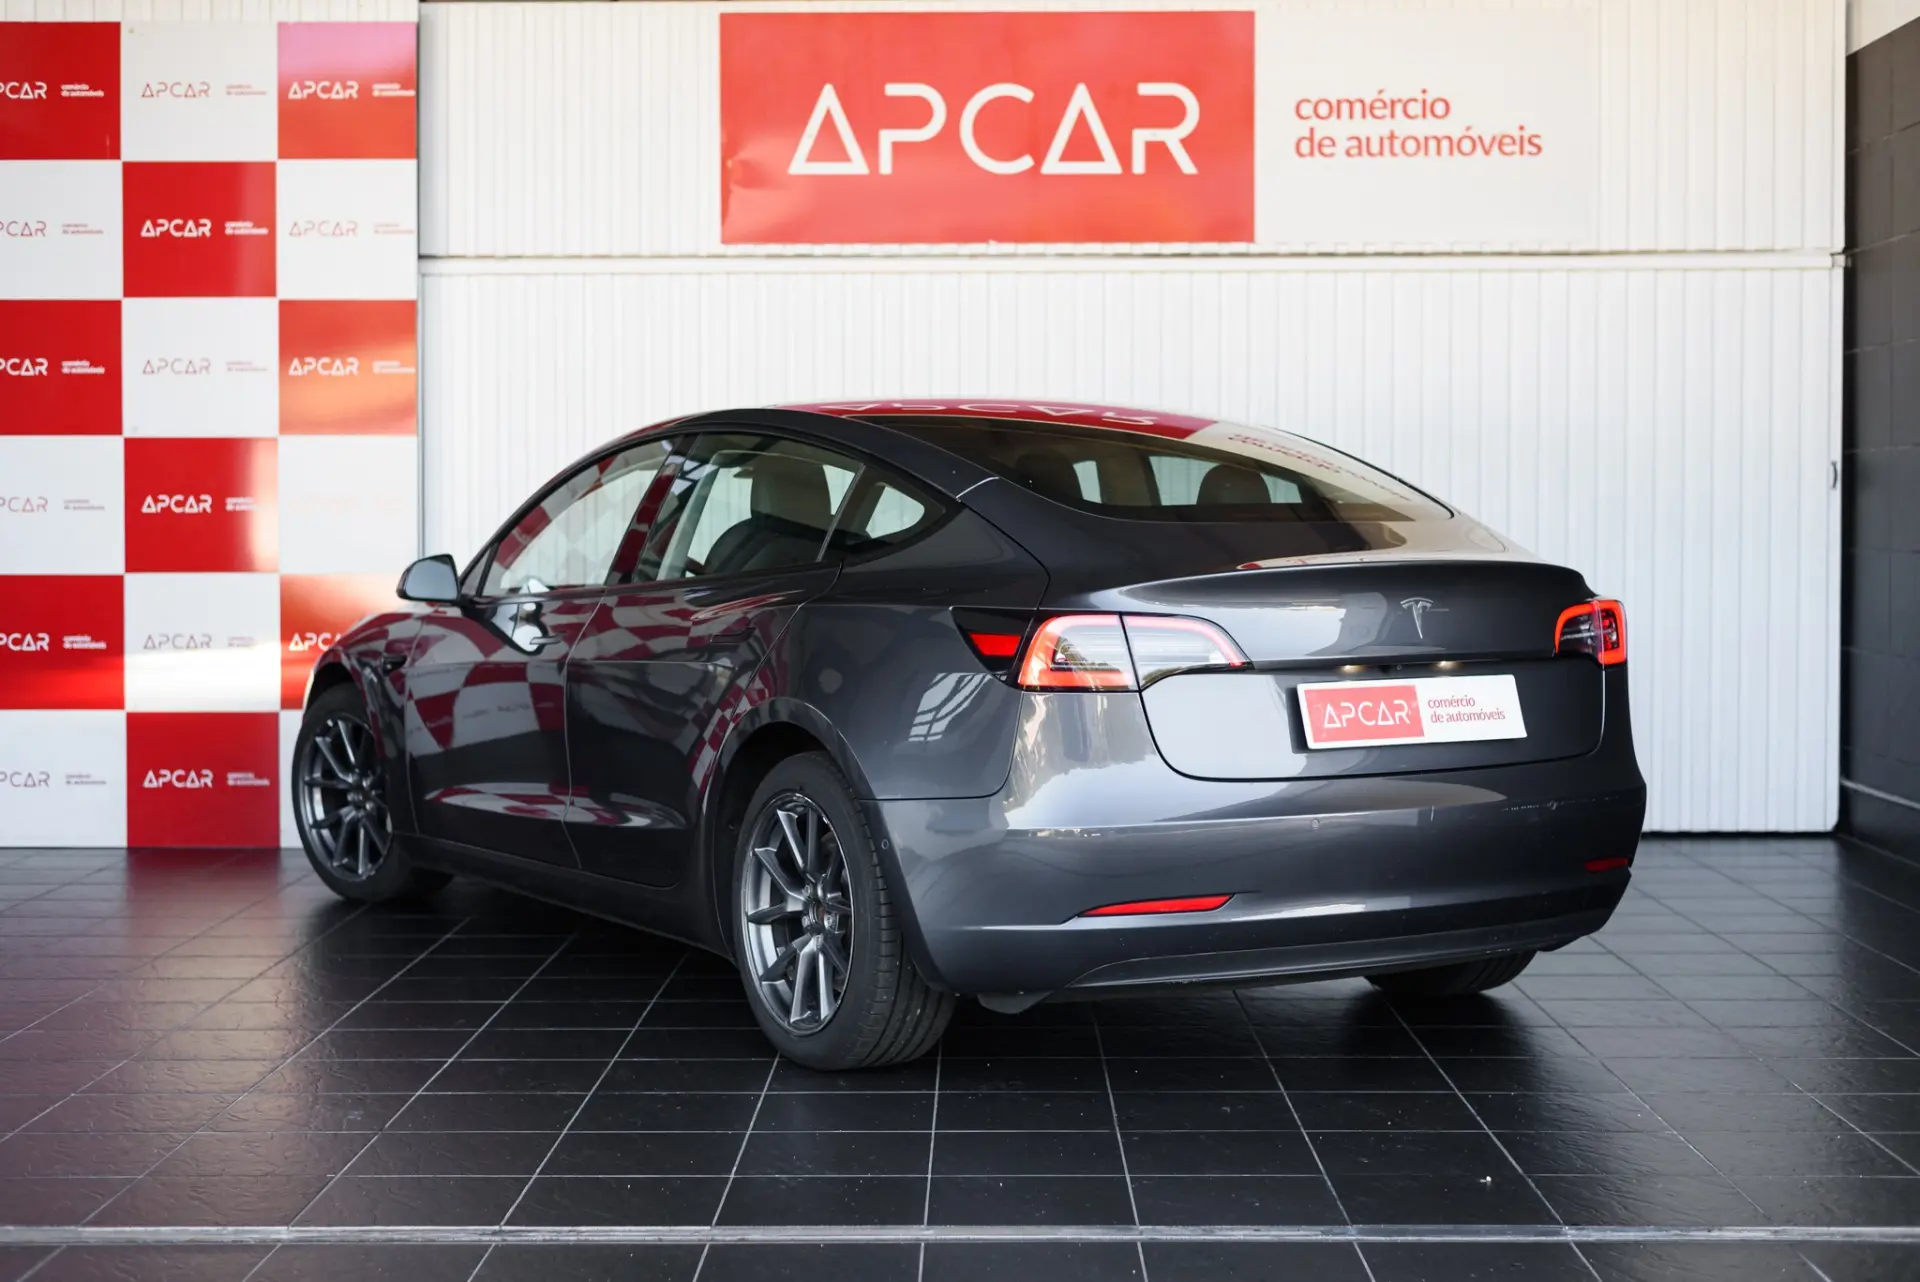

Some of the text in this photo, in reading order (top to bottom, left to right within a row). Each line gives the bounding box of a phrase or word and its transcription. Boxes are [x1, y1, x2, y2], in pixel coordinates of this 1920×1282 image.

[0, 82, 47, 99] CAR
[141, 82, 210, 99] APCAR
[287, 80, 359, 100] APCAR
[1295, 89, 1451, 120] comércio
[788, 83, 1200, 175] APCAR
[1295, 125, 1542, 158] de automóveis
[0, 220, 47, 237] CAR
[140, 218, 212, 238] APCAR
[0, 358, 48, 376] CAR
[142, 358, 211, 376] APCAR
[287, 357, 359, 377] APCAR
[0, 496, 48, 513] CAR
[141, 494, 212, 514] APCAR
[0, 633, 49, 651] PCAR
[143, 633, 212, 650] APCAR
[288, 632, 344, 652] APC
[1427, 694, 1476, 709] comércio
[1324, 700, 1412, 728] APCAR
[1431, 708, 1506, 723] de automóveis
[0, 770, 50, 789] PCAR
[142, 769, 213, 789] APCAR
